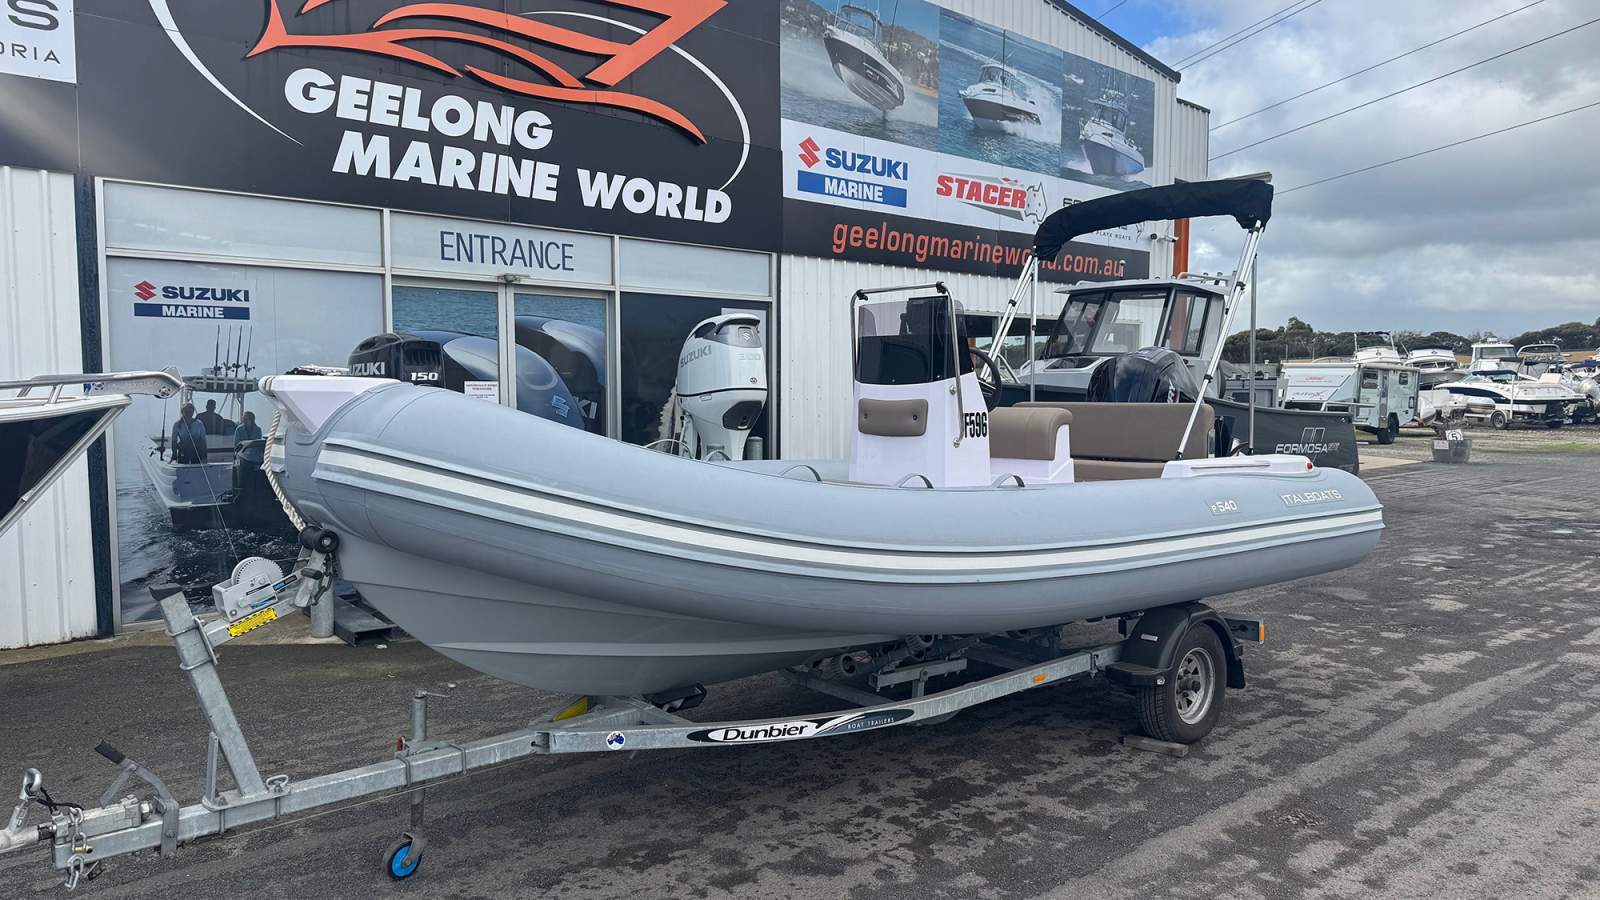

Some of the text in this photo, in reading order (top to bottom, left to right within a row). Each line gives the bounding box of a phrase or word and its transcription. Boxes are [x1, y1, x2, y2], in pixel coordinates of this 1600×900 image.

[284, 68, 553, 150] GEELONG
[825, 148, 909, 181] SUZUKI
[332, 130, 732, 224] MARINE WORLD
[824, 177, 884, 203] MARINE
[936, 175, 1027, 209] STACER
[440, 230, 575, 272] ENTRANCE
[832, 222, 1123, 278] geelongmarinewo.com.au
[161, 285, 250, 303] SUZUKI
[161, 305, 225, 318] MARINE
[680, 344, 713, 368] SUZUKI
[410, 372, 439, 381] 150
[1275, 443, 1328, 454] FORMOSA
[1215, 500, 1238, 512] 540
[1280, 489, 1342, 506] ITALBOATS
[722, 724, 809, 742] Dunbier
